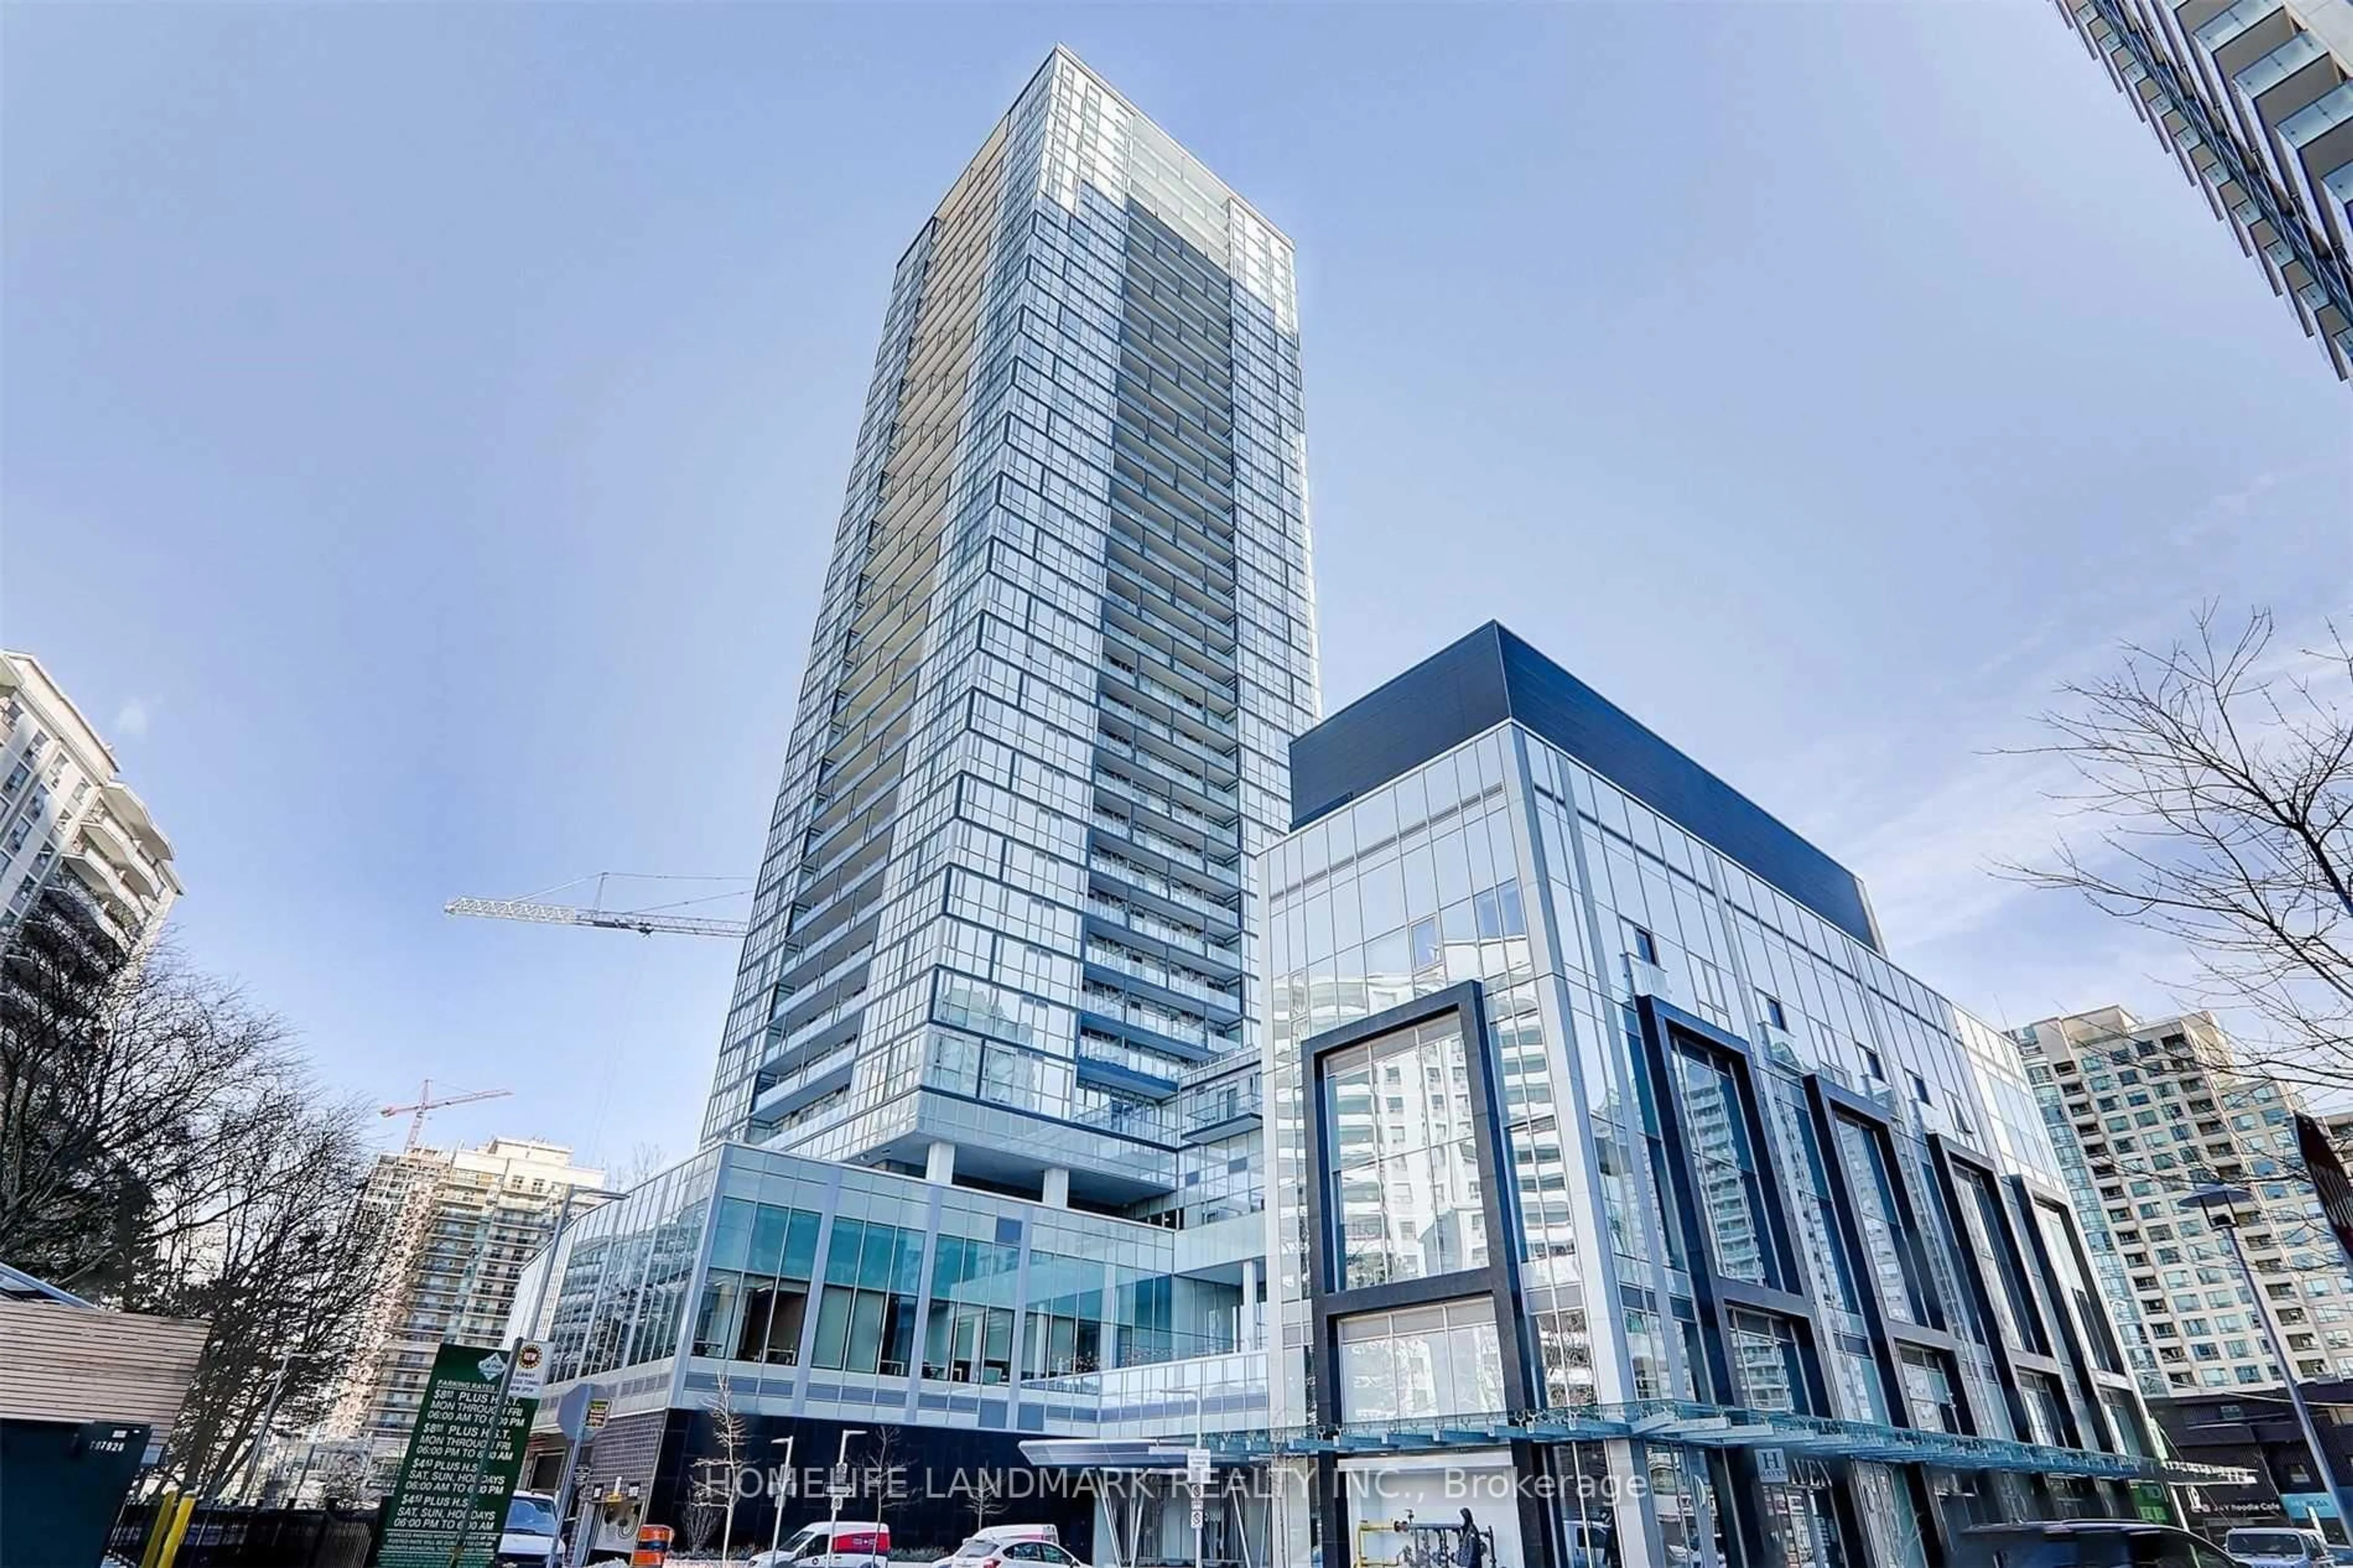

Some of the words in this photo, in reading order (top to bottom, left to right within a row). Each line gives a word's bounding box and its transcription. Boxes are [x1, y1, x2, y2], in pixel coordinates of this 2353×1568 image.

[458, 1392, 488, 1404] PLUS
[491, 1395, 520, 1406] HS.T.
[430, 1400, 455, 1411] MON
[507, 1407, 523, 1417] FRI
[427, 1411, 453, 1420] 06:00
[455, 1413, 471, 1422] AM
[474, 1414, 487, 1423] TO
[509, 1417, 525, 1427] PM
[448, 1425, 479, 1437] PLUS
[480, 1428, 511, 1440] HS.T.
[419, 1435, 444, 1445] MON
[496, 1441, 512, 1450] FRI
[417, 1445, 443, 1455] 06:00
[444, 1447, 460, 1456] PM
[462, 1449, 476, 1458] TO
[477, 1450, 496, 1460] 60
[496, 1452, 513, 1461] AM
[434, 1460, 461, 1471] PLUS
[457, 1473, 506, 1485] HOLDAYS
[406, 1480, 433, 1491] 06:00
[433, 1482, 450, 1491] AM
[452, 1483, 466, 1493] TO
[467, 1484, 487, 1494] 60
[488, 1485, 504, 1494] PM
[423, 1496, 450, 1507] PLUS
[447, 1509, 496, 1521] HOLDAYS
[394, 1518, 422, 1528] 06:00
[422, 1518, 439, 1528] PM
[442, 1519, 455, 1529] TO
[478, 1521, 495, 1531] AM
